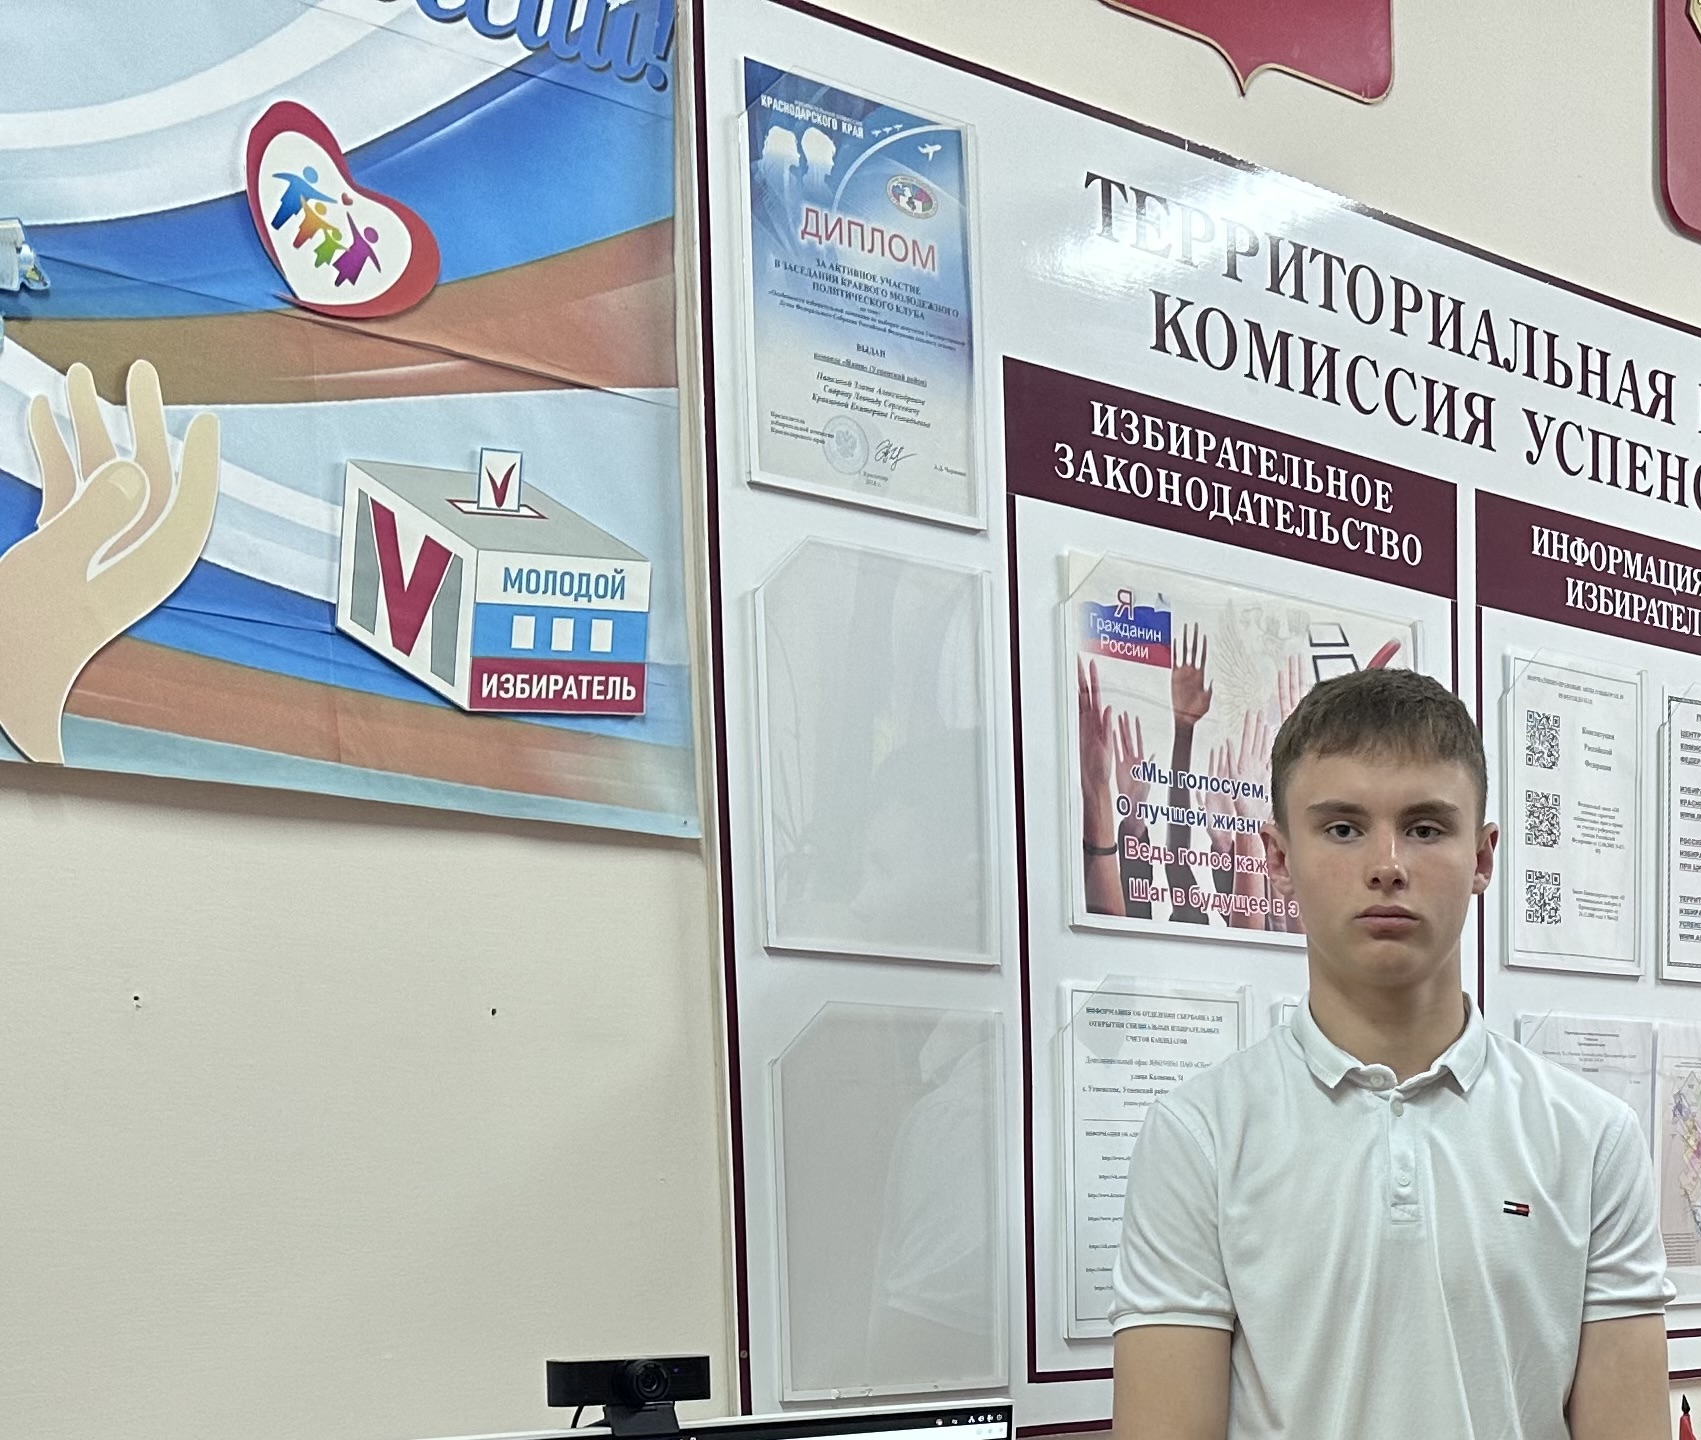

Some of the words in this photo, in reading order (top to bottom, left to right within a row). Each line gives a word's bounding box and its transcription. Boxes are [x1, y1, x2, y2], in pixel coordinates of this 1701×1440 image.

[761, 94, 838, 131] КРАСНОДАРСКОГО
[842, 121, 864, 139] КРАЯ
[800, 207, 936, 272] ДИПЛОМ
[812, 281, 895, 312] ПОЛИТИЧЕСКОГО
[829, 262, 878, 284] АКТИВНОЕ
[879, 275, 922, 295] УЧАСТИЕ
[840, 277, 888, 298] КРАЕВОГО
[1084, 171, 1677, 426] ТЕРРИТОРИАЛЬНАЯ
[1149, 288, 1497, 453] КОМИССИЯ
[1090, 401, 1394, 514] ИЗБИРАТЕЛЬНОЕ
[1054, 442, 1423, 567] ЗАКОНОДАТЕЛЬСТВО
[502, 567, 627, 602] МОЛОДОЙ
[1114, 589, 1134, 620] Я
[1089, 612, 1162, 642] Гражданин
[1100, 633, 1149, 659] России
[480, 672, 638, 701] ИЗБИРАТЕЛЬ
[1131, 761, 1173, 785] «Мы
[1178, 771, 1270, 803] голосуем,
[1116, 795, 1131, 816] О
[1136, 802, 1207, 828] лучшей
[1124, 836, 1175, 864] Ведь
[1178, 848, 1232, 871] голос
[1236, 855, 1270, 877] каж
[1129, 877, 1168, 903] Шаг
[1173, 888, 1186, 905] в
[1189, 886, 1269, 916] будущее
[1272, 898, 1285, 915] в
[1287, 901, 1300, 917] э
